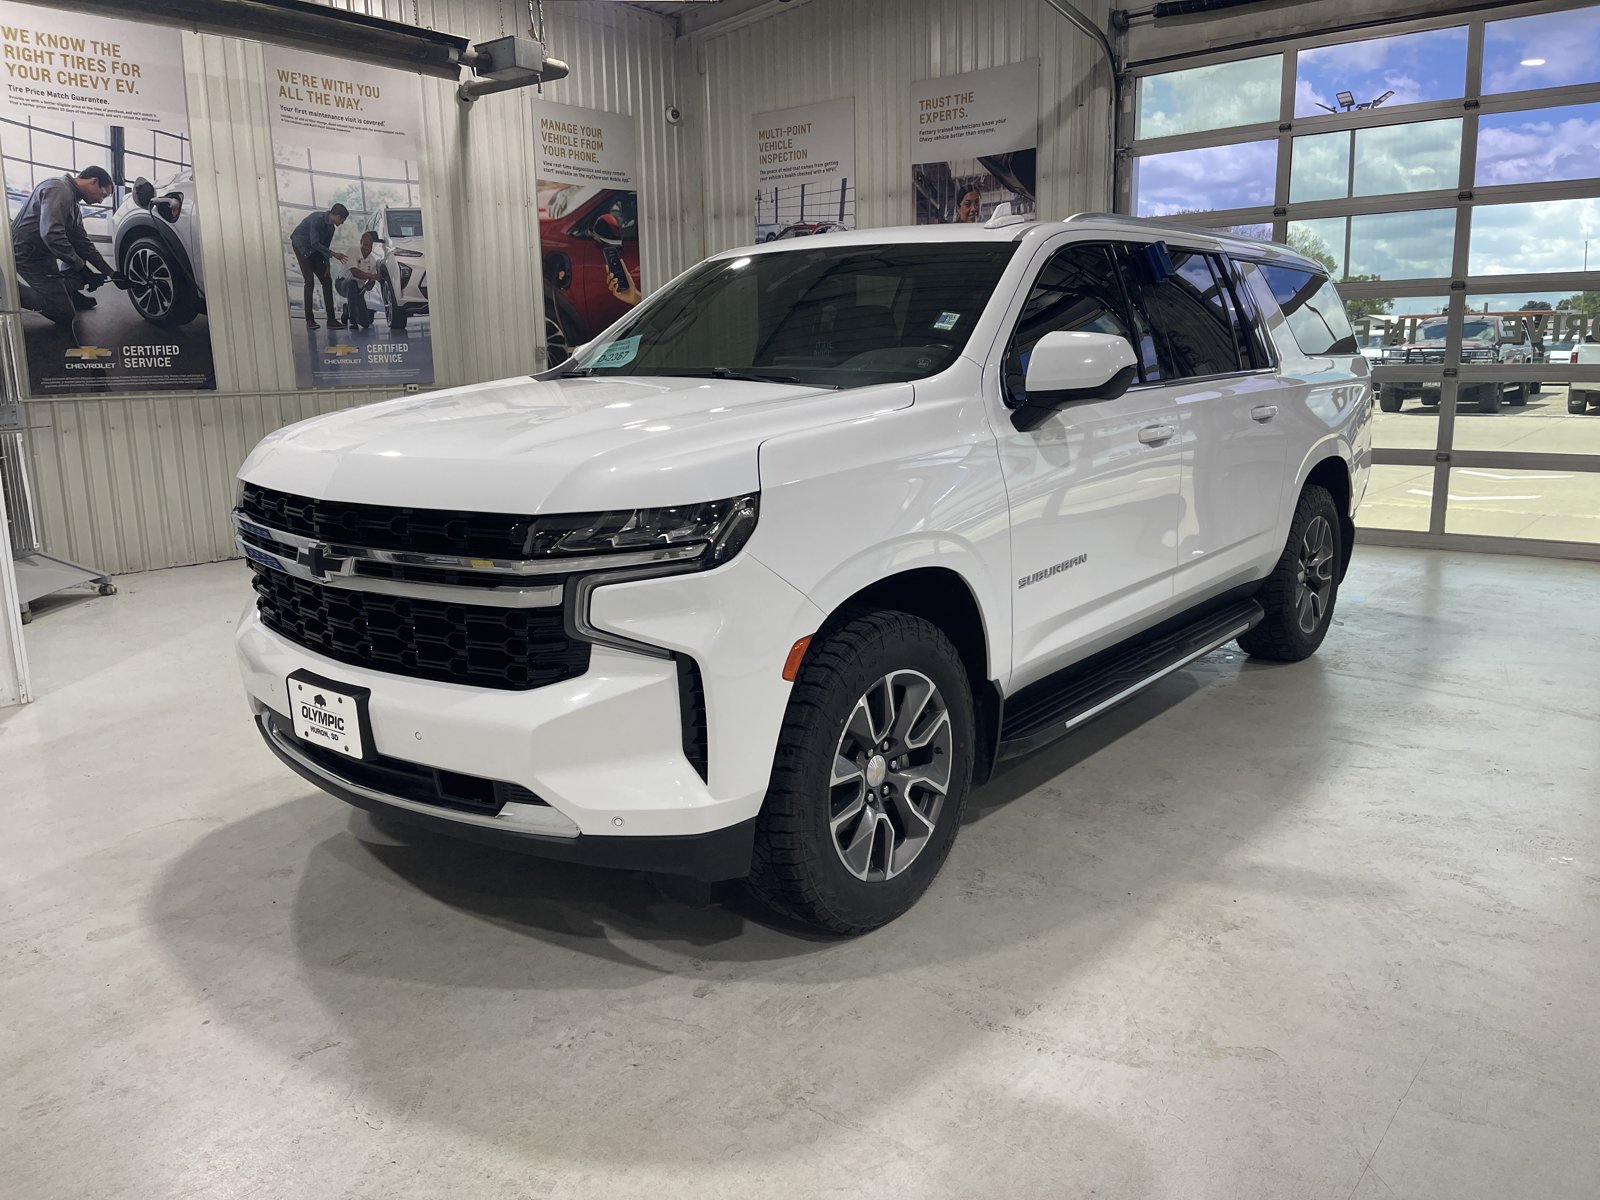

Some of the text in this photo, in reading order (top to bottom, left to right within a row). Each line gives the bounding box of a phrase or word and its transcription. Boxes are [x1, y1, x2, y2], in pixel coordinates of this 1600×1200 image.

[1, 26, 121, 58] WE KNOW THE
[4, 44, 141, 77] RIGHT TIRES FOR
[5, 62, 139, 94] YOUR CHEVY EV.
[277, 69, 380, 98] WE'RE WITH YOU
[8, 84, 110, 105] Tire Price Match Guarantee.
[279, 86, 363, 111] ALL THE WAY.
[920, 91, 975, 111] TRUST THE
[294, 107, 308, 115] first
[308, 110, 344, 121] maintenance
[920, 108, 968, 125] EXPERTS.
[541, 118, 603, 139] MANAGE YOUR
[759, 123, 812, 141] MULTI-POINT
[541, 132, 604, 151] VEHICLE FROM
[759, 139, 793, 153] VEHICLE
[542, 144, 600, 164] YOUR PHONE.
[760, 149, 808, 165] INSPECTION
[123, 345, 179, 356] CERTIFIED
[367, 343, 408, 353] CERTIFIED
[124, 357, 172, 368] SERVICE
[368, 354, 403, 363] SERVICE
[1018, 553, 1087, 589] SUBURBAN
[301, 705, 344, 731] OLYMPIC
[310, 726, 339, 741] HURON, SD
